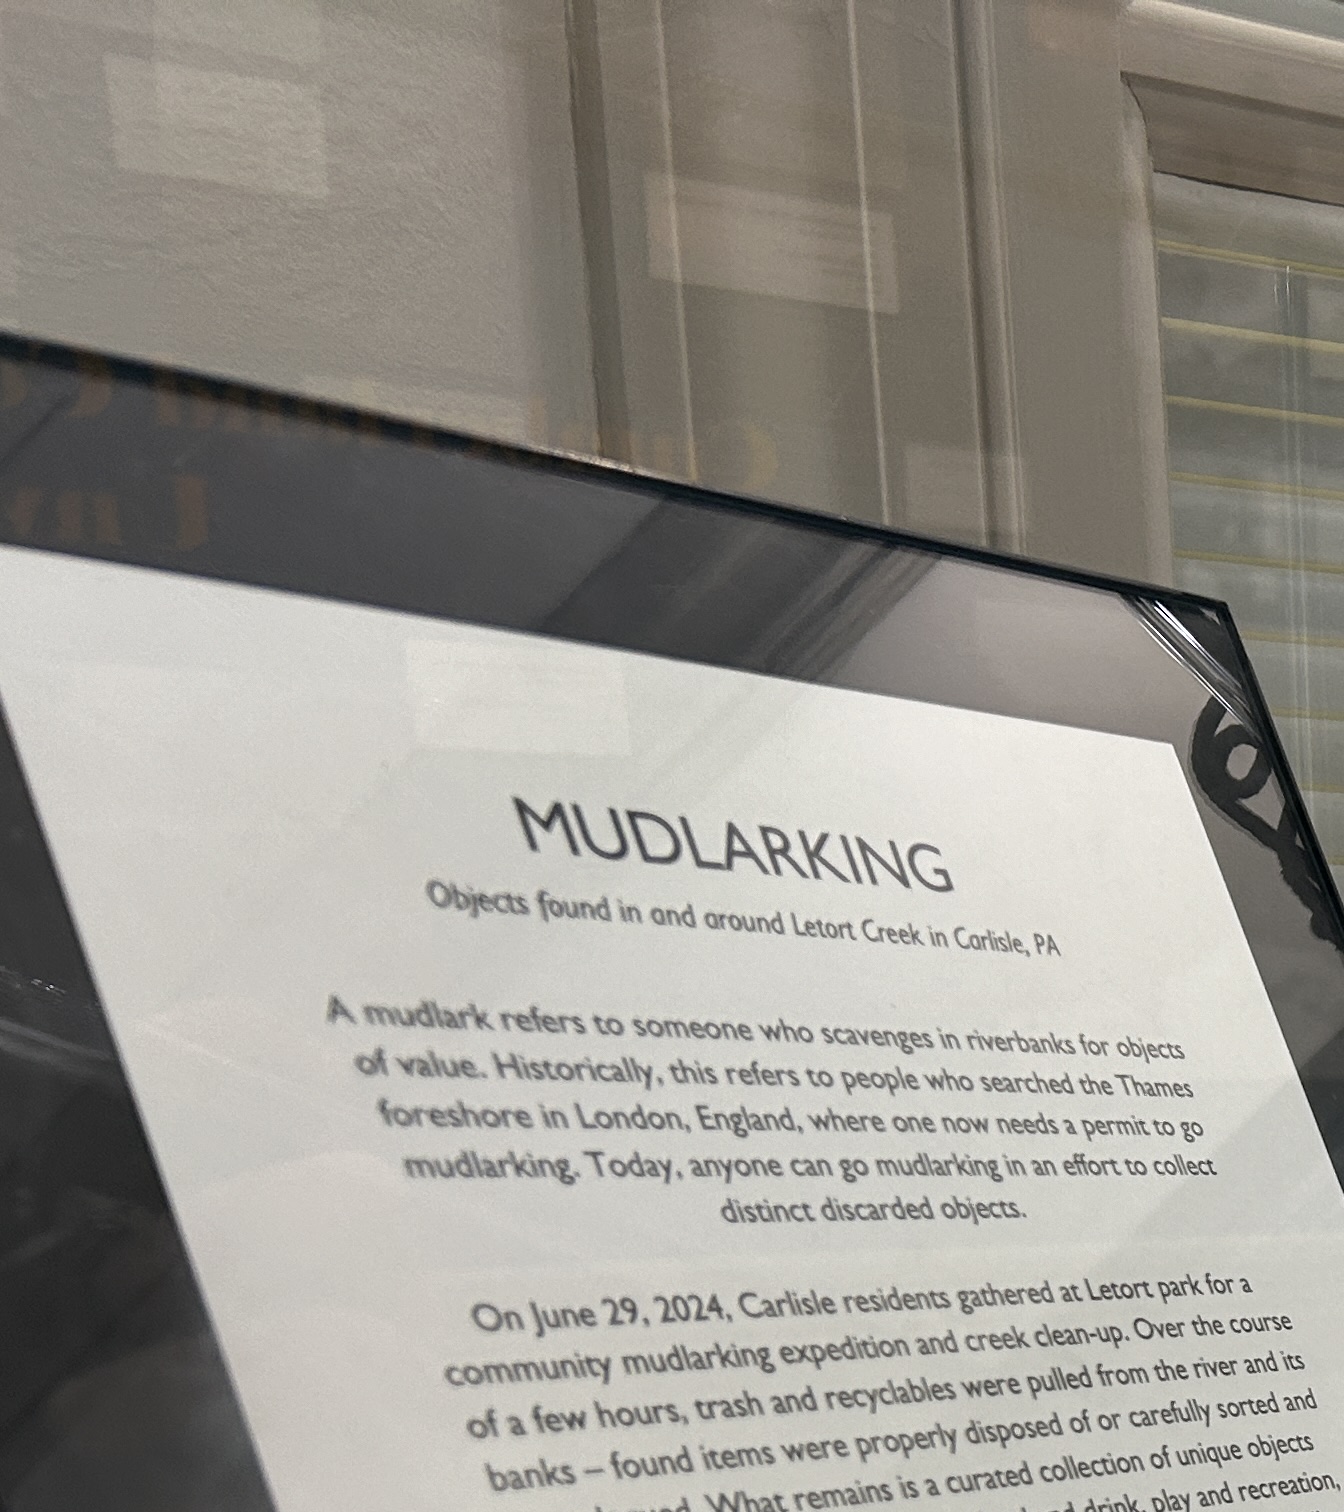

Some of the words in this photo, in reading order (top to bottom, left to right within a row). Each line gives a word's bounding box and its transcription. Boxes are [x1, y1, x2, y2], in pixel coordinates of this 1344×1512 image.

[511, 796, 955, 893] MUDLARKING
[425, 879, 531, 918] Objects
[535, 889, 612, 922] found
[617, 899, 643, 924] in
[650, 903, 697, 929] and
[703, 911, 786, 935] around
[790, 912, 857, 941] Letort
[860, 918, 925, 946] Creek
[927, 925, 949, 948] in
[953, 926, 1031, 958] Carlisle,
[1033, 933, 1062, 957] PA
[327, 995, 357, 1025] A
[362, 1000, 495, 1030] mudlark
[498, 1005, 587, 1035] refers
[592, 1015, 625, 1036] to
[631, 1019, 754, 1042] someone
[758, 1018, 814, 1043] who
[820, 1027, 935, 1055] scavenges
[936, 1027, 962, 1050] in
[965, 1030, 1077, 1055] riverbanks
[1078, 1033, 1109, 1056] for
[1116, 1035, 1185, 1064] objects
[354, 1047, 389, 1077] of
[395, 1051, 488, 1079] value.
[491, 1052, 664, 1091] Historically,
[667, 1059, 719, 1085] this
[724, 1060, 801, 1087] refers
[804, 1068, 834, 1088] to
[840, 1066, 921, 1097] people
[923, 1068, 975, 1092] who
[979, 1071, 1075, 1095] searched
[1078, 1073, 1115, 1096] the
[1114, 1074, 1194, 1099] Thames
[470, 1302, 525, 1333] On
[528, 1301, 598, 1338] June
[601, 1296, 650, 1327] 29,
[653, 1293, 733, 1323] 2024,
[737, 1289, 838, 1319] Carlisle
[842, 1286, 952, 1313] residents
[956, 1280, 1055, 1315] gathered
[1058, 1284, 1084, 1302] at
[1083, 1278, 1155, 1301] Letort
[1157, 1273, 1204, 1305] park
[1205, 1272, 1234, 1295] for
[1239, 1278, 1253, 1293] a
[444, 1353, 612, 1387] community
[621, 1342, 777, 1375] mudlarking
[778, 1335, 911, 1370] expedition
[915, 1329, 960, 1356] and
[964, 1326, 1031, 1352] creek
[1034, 1323, 1130, 1350] clean-up.
[1132, 1317, 1185, 1340] Over
[1191, 1314, 1226, 1336] the
[1229, 1316, 1293, 1334] course
